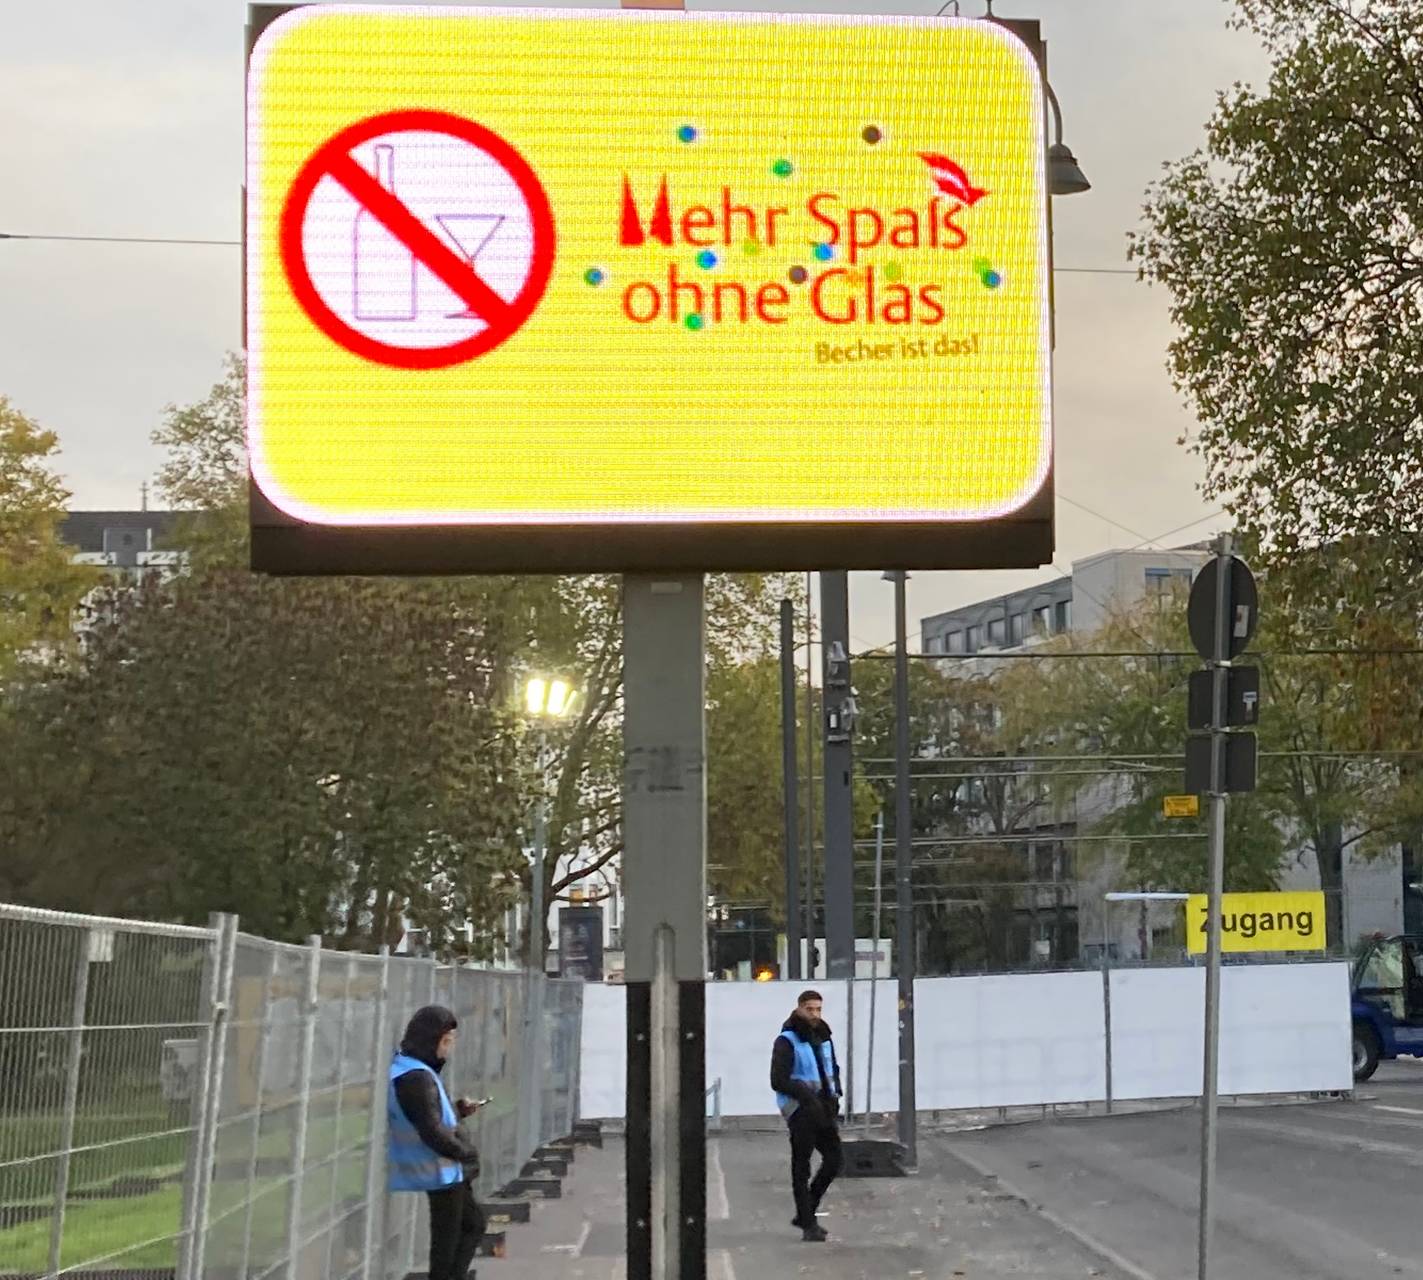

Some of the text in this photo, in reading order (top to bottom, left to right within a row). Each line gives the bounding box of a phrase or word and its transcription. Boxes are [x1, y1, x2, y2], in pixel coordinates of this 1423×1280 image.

[618, 172, 969, 266] Mehr Spaß
[622, 263, 946, 326] ohne Glas
[816, 333, 980, 365] Becher ist das!
